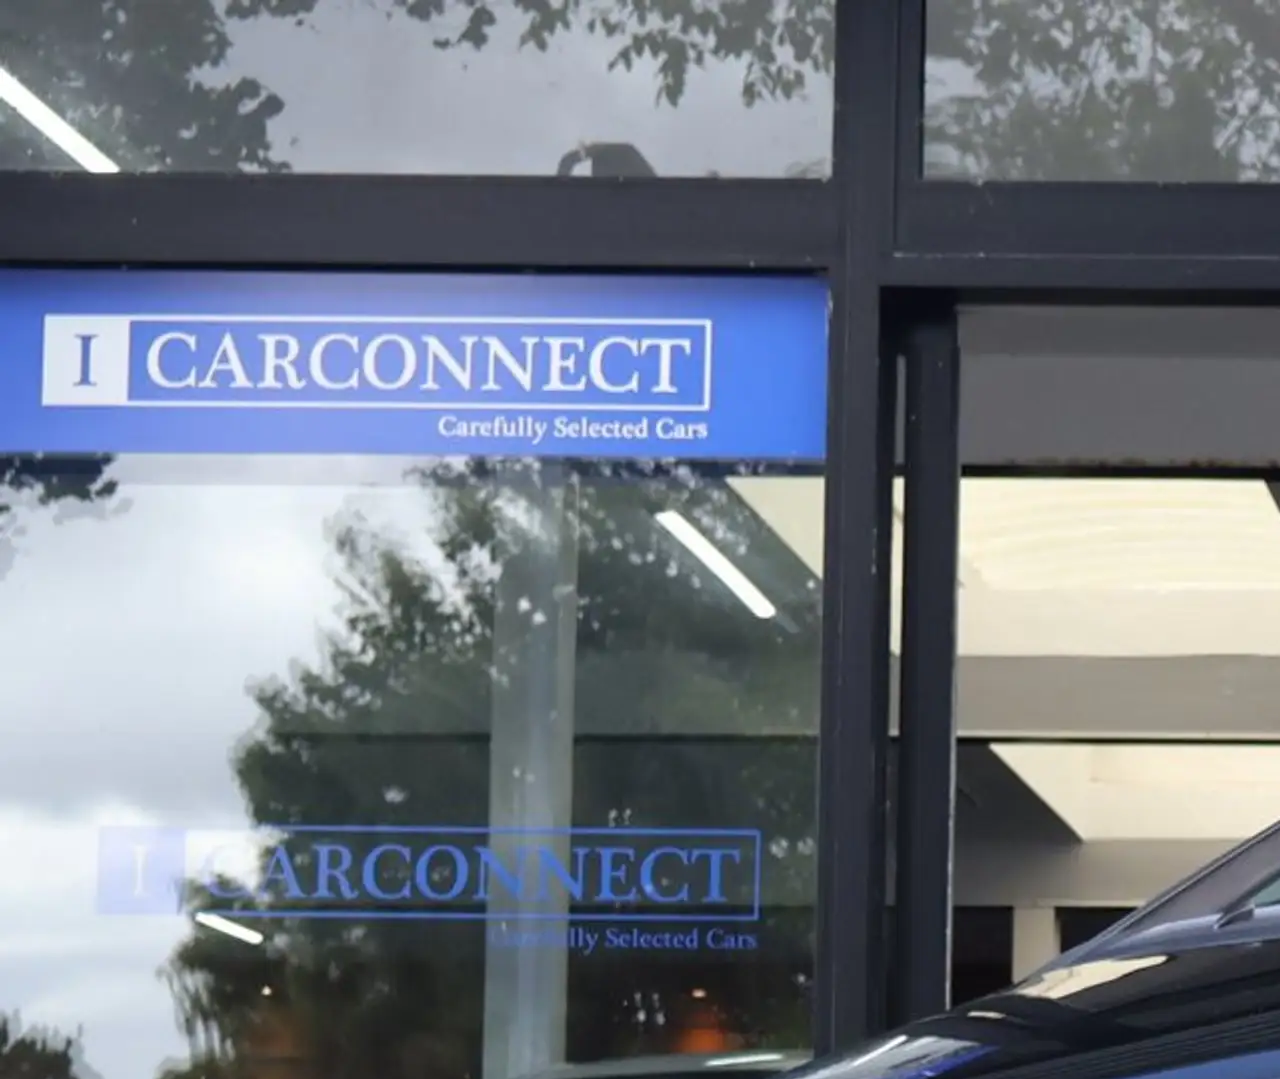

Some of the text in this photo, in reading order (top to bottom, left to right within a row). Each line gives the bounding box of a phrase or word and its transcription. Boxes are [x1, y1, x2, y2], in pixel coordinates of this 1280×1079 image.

[72, 332, 692, 394] I CARCONNECT
[438, 415, 708, 444] Carefully Selected Cars
[201, 842, 741, 903] CARCONNECT
[604, 927, 699, 950] Selected
[706, 927, 758, 950] Cars
